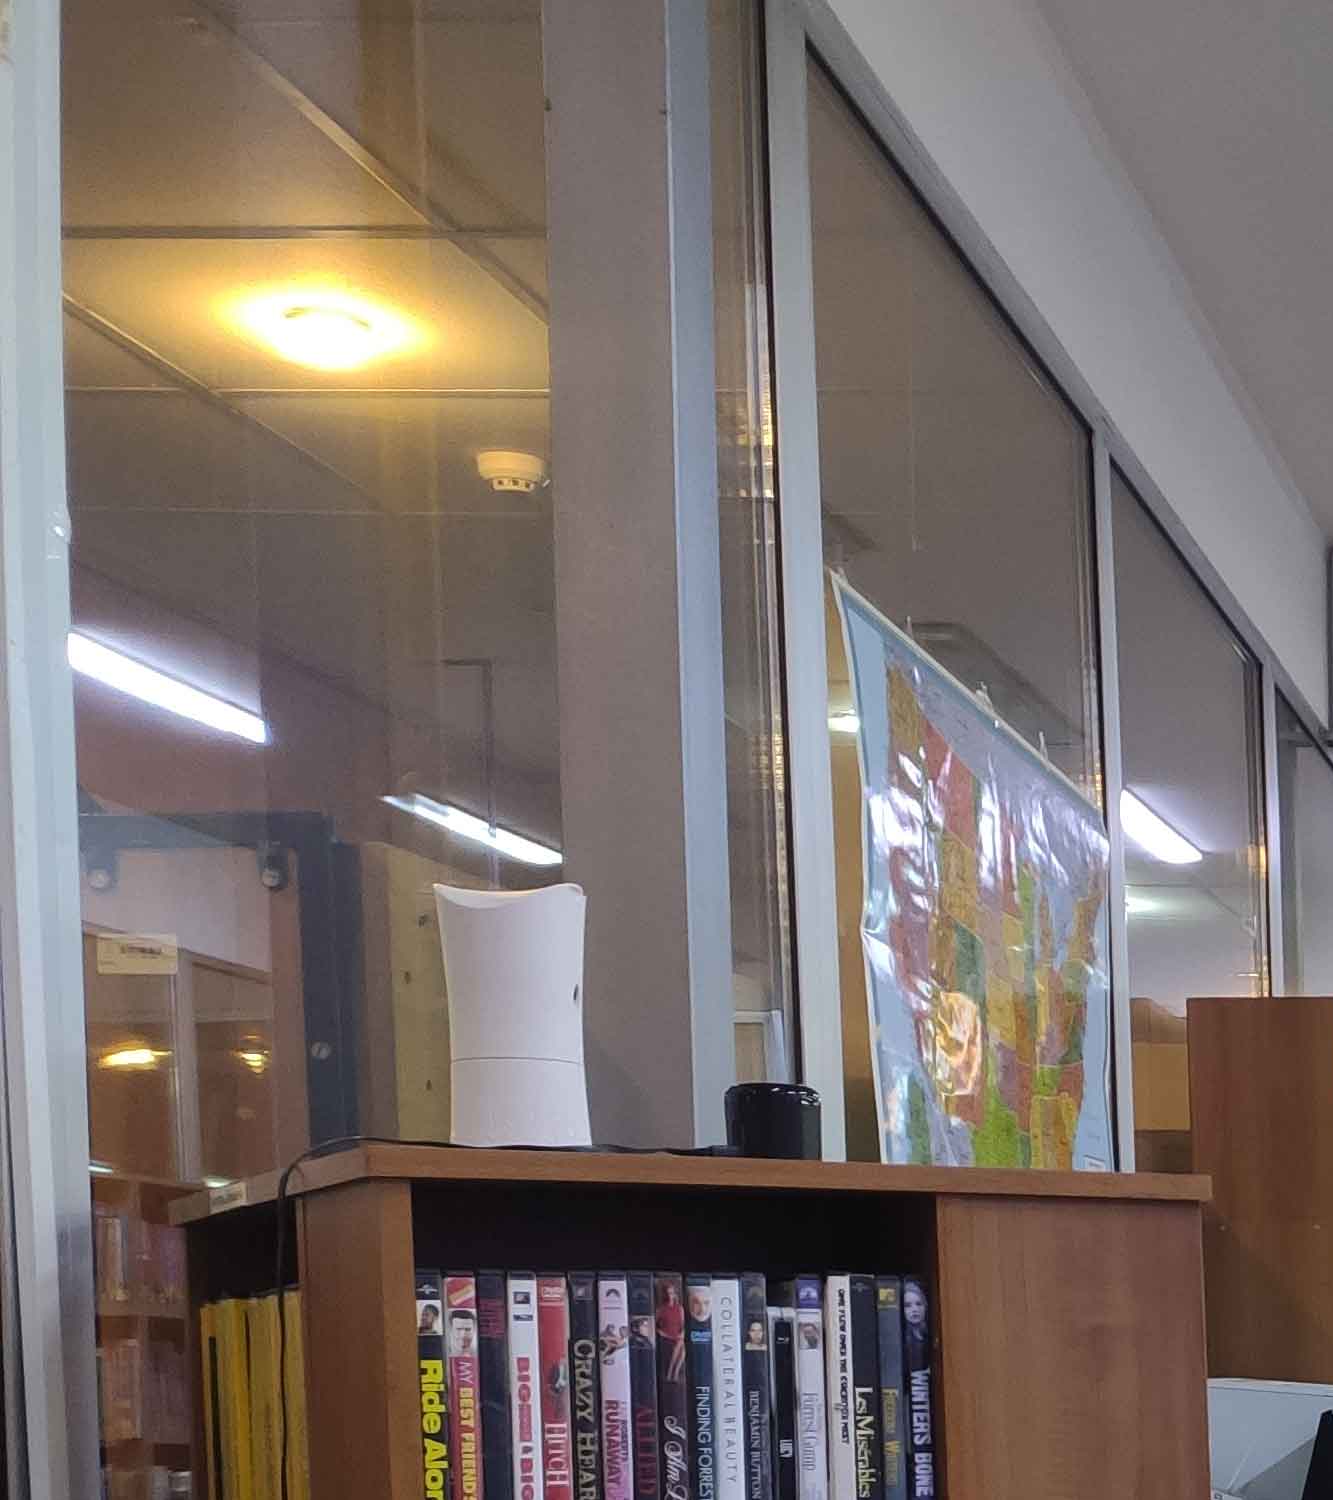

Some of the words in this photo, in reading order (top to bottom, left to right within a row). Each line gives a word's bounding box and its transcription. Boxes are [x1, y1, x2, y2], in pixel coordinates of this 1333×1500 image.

[458, 1361, 473, 1383] MY
[516, 1357, 531, 1404] BIG
[573, 1339, 597, 1424] CRAZY
[720, 1296, 738, 1409] COLLATERAL
[420, 1360, 442, 1433] Ride
[459, 1388, 475, 1429] BEST
[695, 1386, 712, 1444] FINDING
[747, 1390, 762, 1449] BENJAMIN
[854, 1386, 873, 1415] Les
[544, 1423, 570, 1487] HITCH
[605, 1400, 622, 1486] RUNAWAY
[723, 1417, 739, 1484] BEAUTY
[778, 1439, 793, 1458] LUCY
[854, 1415, 877, 1499] Misérables
[750, 1451, 763, 1500] BUTTON
[914, 1452, 934, 1498] BONE
